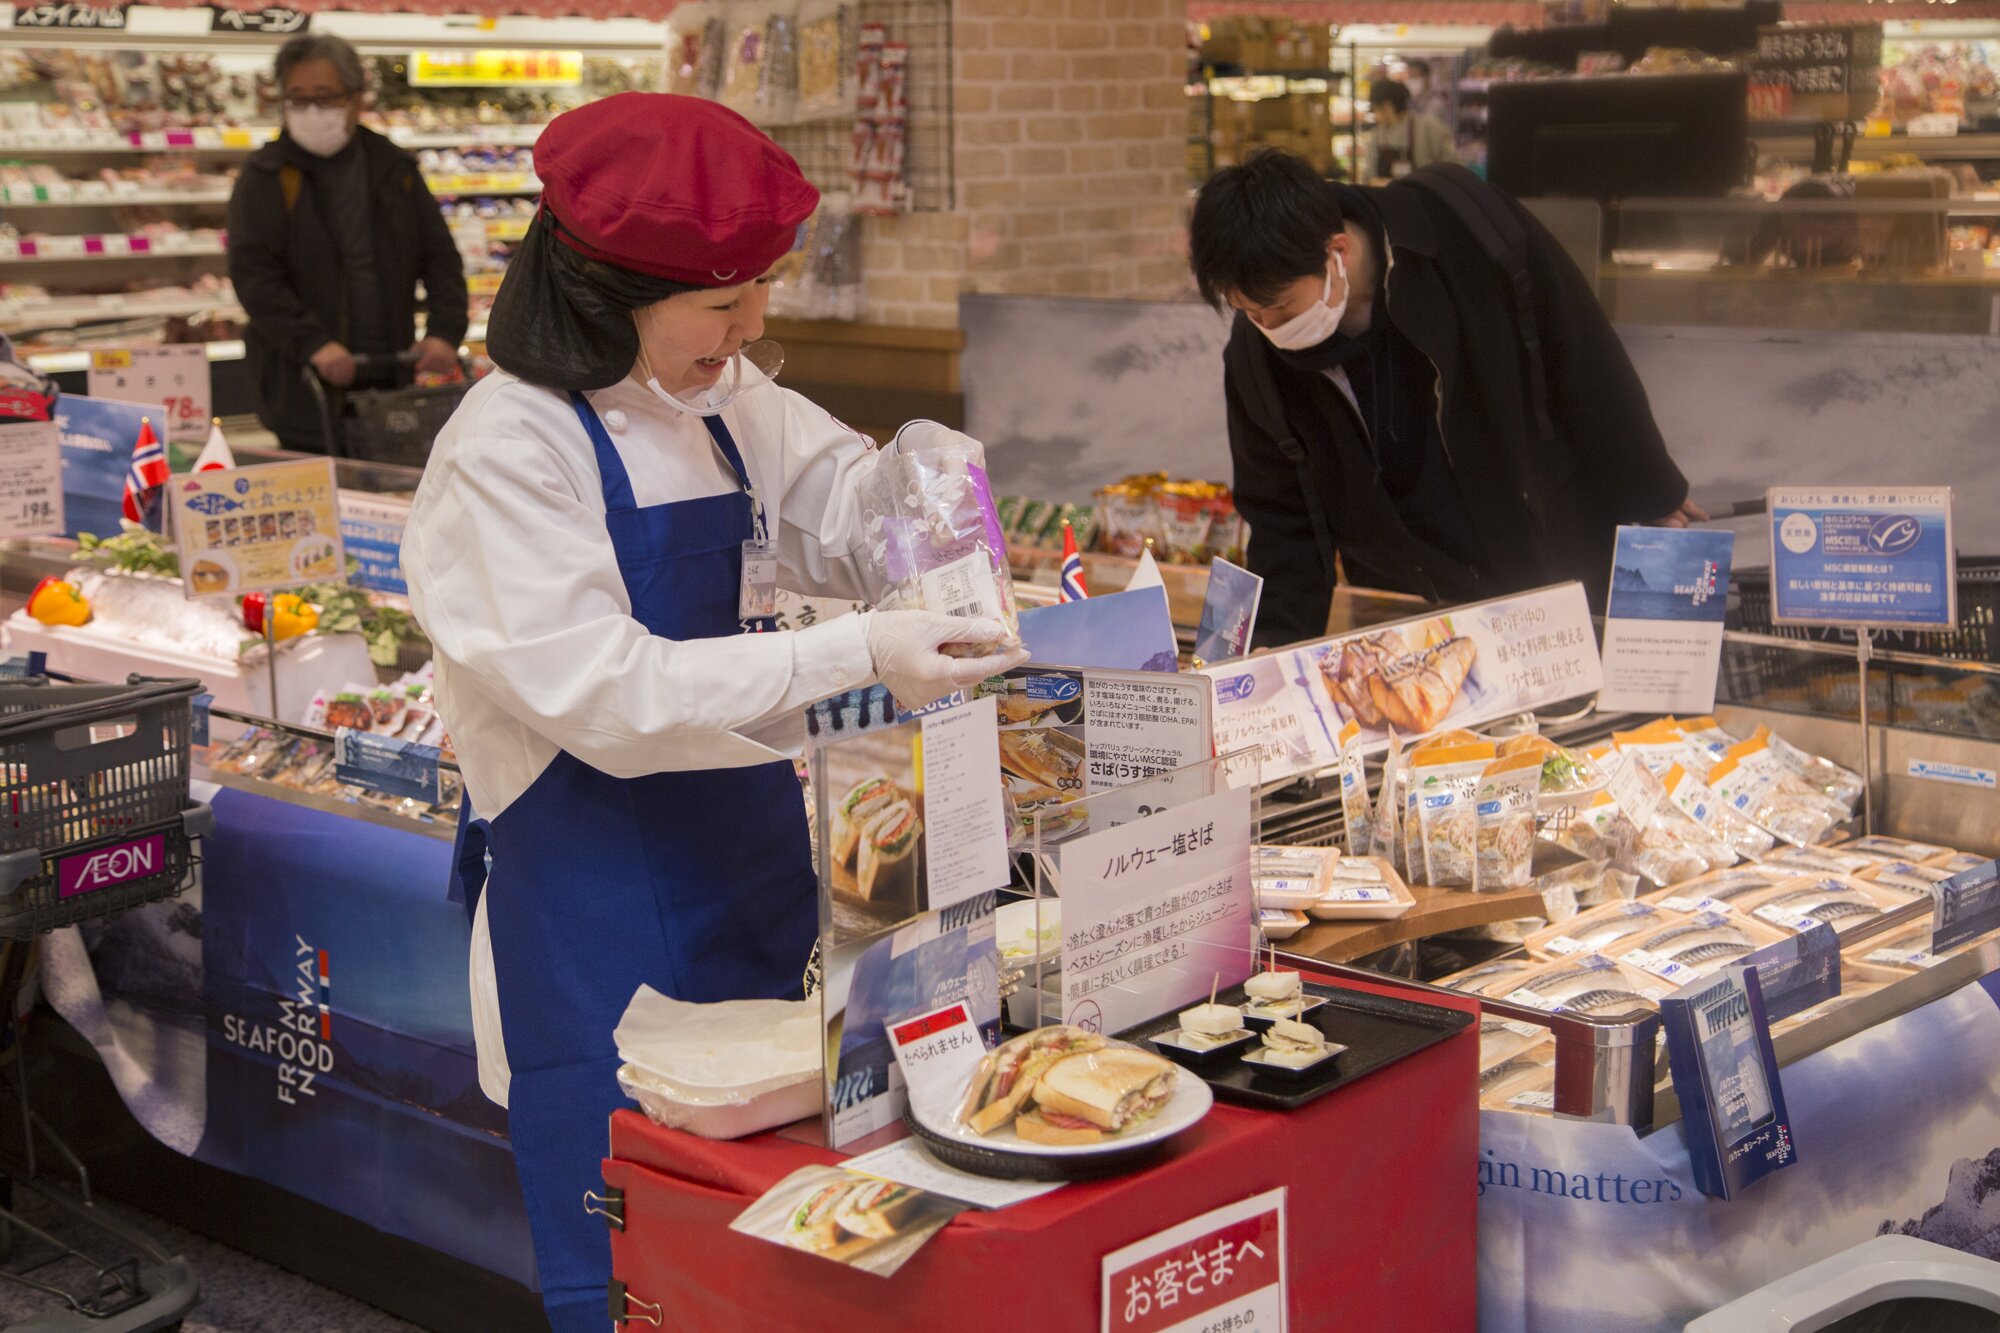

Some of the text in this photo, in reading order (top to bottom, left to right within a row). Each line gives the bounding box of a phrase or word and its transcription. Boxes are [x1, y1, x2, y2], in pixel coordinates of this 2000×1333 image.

[1674, 585, 1715, 595] SEAFOOD
[1088, 680, 1182, 696] 脂がのったうす塩味のさばです。
[1089, 700, 1181, 715] いろいろなメニューに使えます。
[1089, 719, 1144, 730] が含まれています。
[1089, 749, 1178, 767] 環境にやさしいMSC認証
[1122, 745, 1183, 757] グリーンアイナチュラル
[1103, 821, 1214, 880] ノルウェー塩さば
[296, 932, 317, 1097] NORWAY
[223, 1013, 334, 1073] SEAFOOD
[277, 1000, 297, 1106] FROM
[904, 1031, 972, 1066] たべられません
[1765, 1144, 1791, 1160] SEAFOOD
[1530, 1172, 1683, 1205] matters
[1124, 1239, 1265, 1324] お客さまへ
